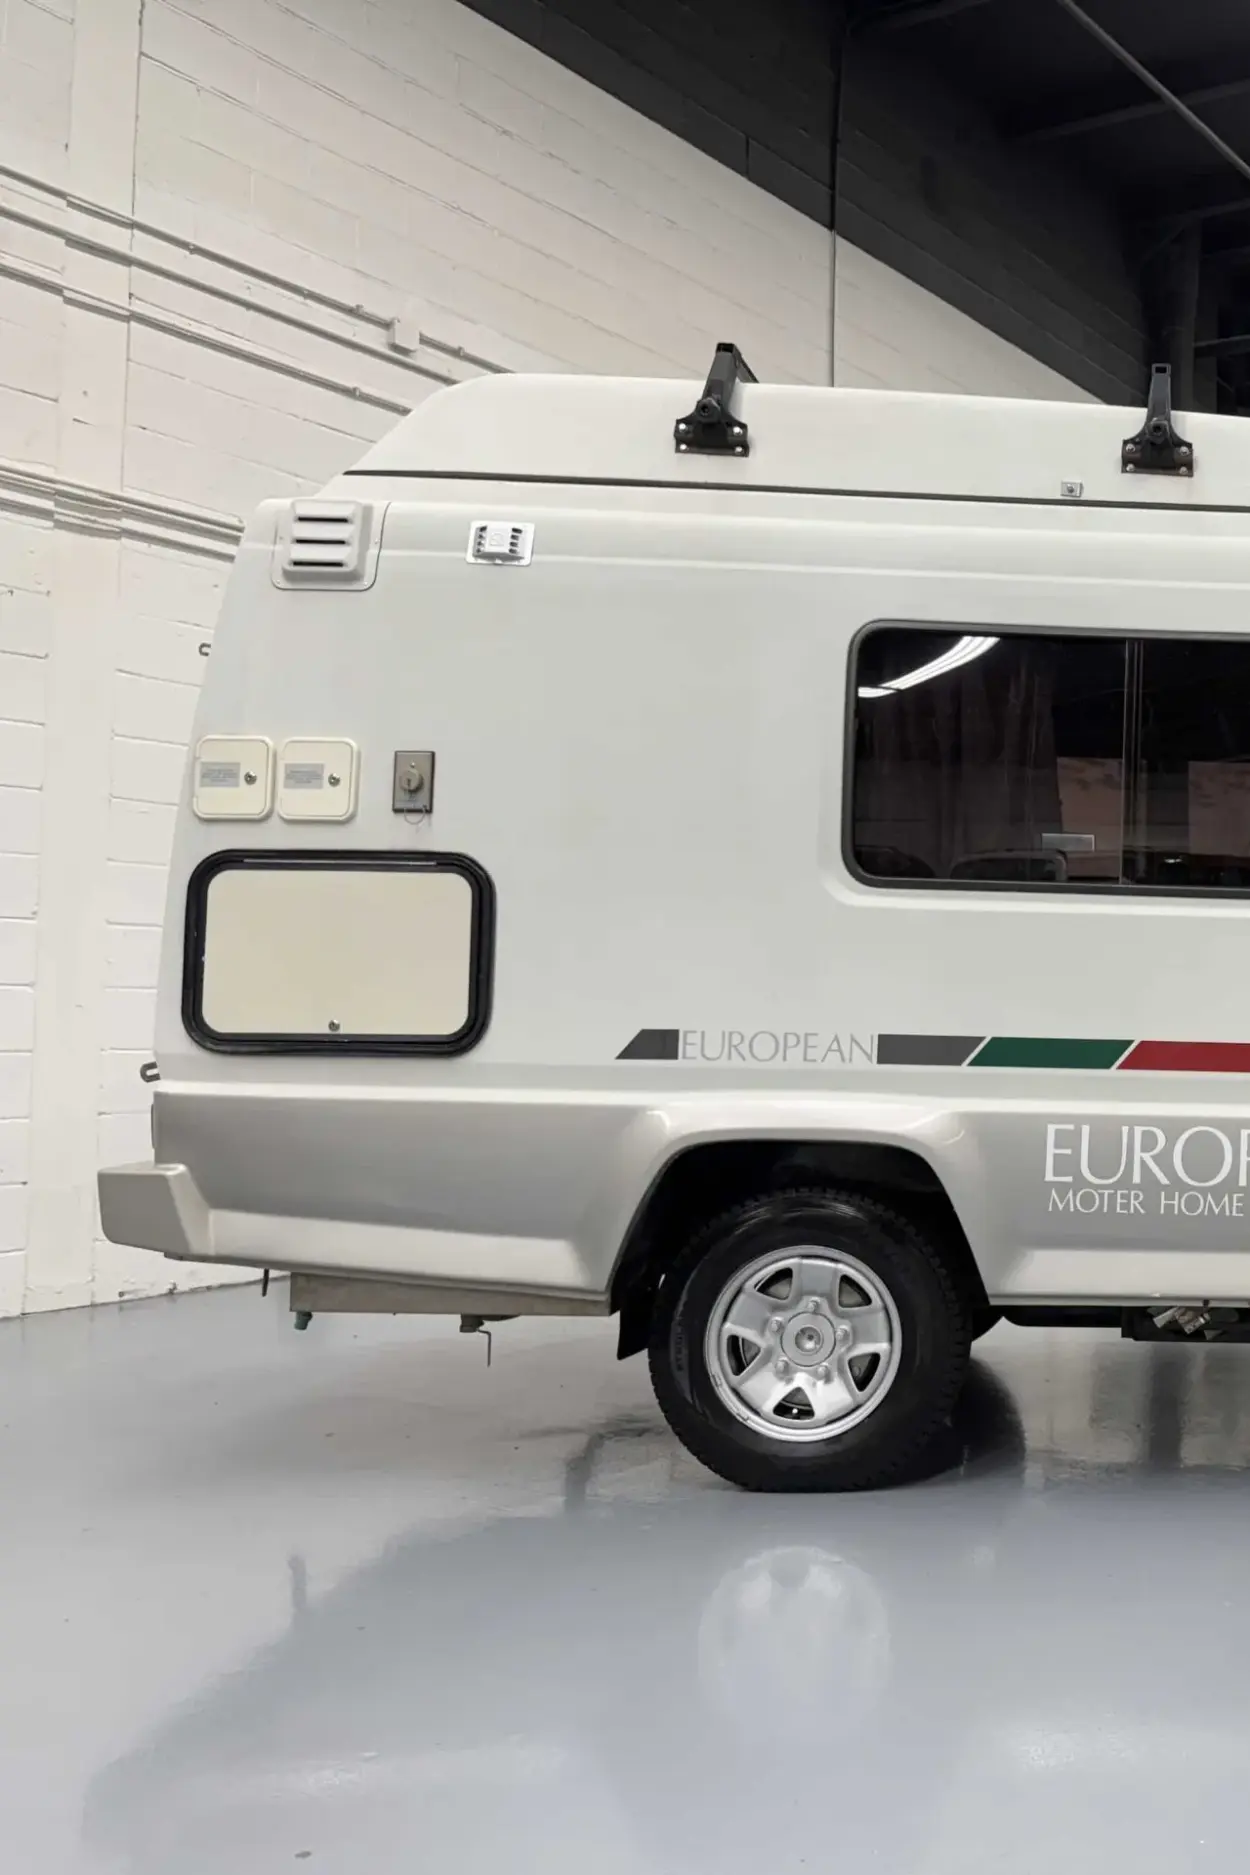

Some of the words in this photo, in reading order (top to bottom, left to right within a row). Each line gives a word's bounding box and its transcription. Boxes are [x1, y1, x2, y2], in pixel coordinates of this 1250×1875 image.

[681, 1029, 874, 1064] EUROPEAN
[1048, 1188, 1146, 1215] MOTER
[1159, 1191, 1245, 1217] HOME
